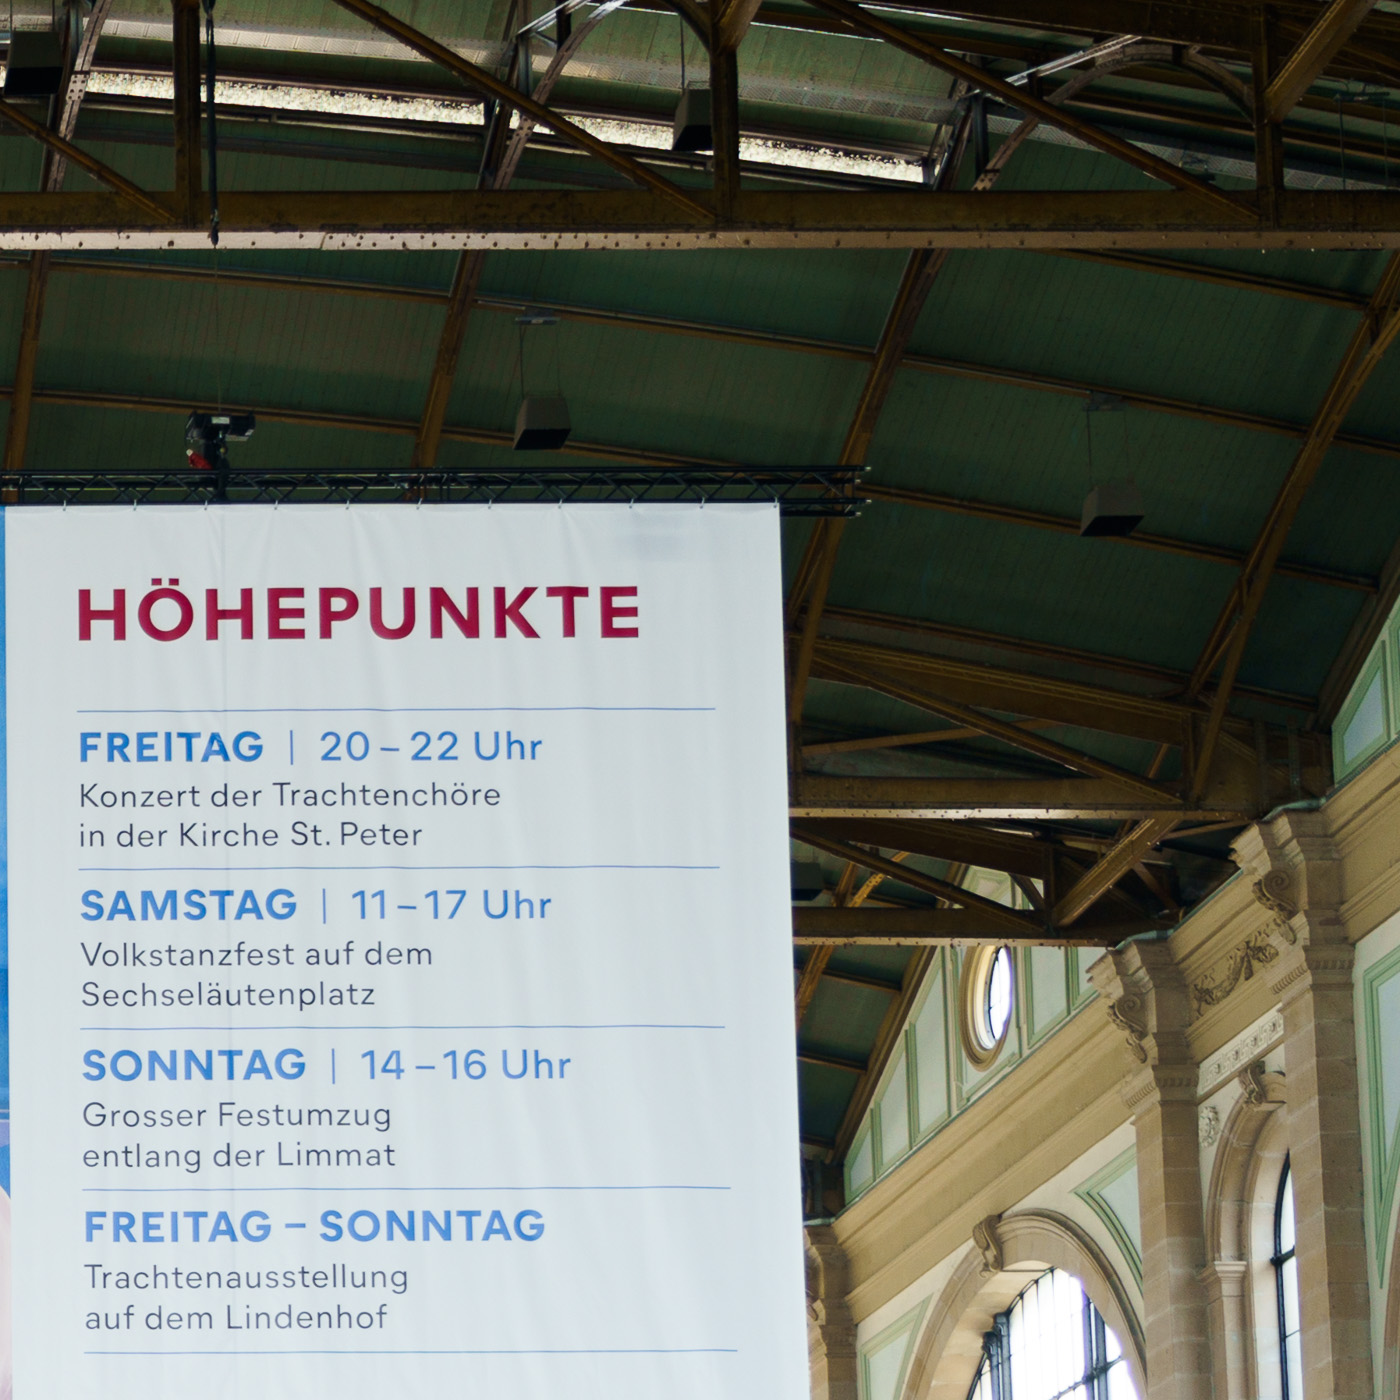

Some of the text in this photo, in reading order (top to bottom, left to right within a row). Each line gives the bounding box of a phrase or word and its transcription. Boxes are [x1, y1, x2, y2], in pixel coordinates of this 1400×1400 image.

[79, 578, 638, 641] HÖHEPUNKTE
[80, 731, 263, 762] FREITAG
[475, 731, 542, 760] Uhr
[81, 782, 500, 807] Konzert der Trachtenchöre
[81, 824, 104, 846] in
[117, 824, 167, 847] der
[181, 823, 278, 846] Kirche
[341, 822, 422, 846] Peter
[81, 889, 296, 921] SAMSTAG
[484, 890, 551, 919] Uhr
[81, 941, 431, 966] Volkstanzfest auf dem
[82, 981, 374, 1011] Sechseläutenplatz
[83, 1048, 305, 1081] SONNTAG
[503, 1049, 571, 1079] Uhr
[84, 1102, 390, 1132] Grosser Festumzug
[83, 1142, 395, 1173] entlang der Limmat
[86, 1211, 271, 1242] FREITAG
[320, 1210, 544, 1242] SONNTAG
[84, 1264, 407, 1294] Trachtenausstellung
[86, 1304, 387, 1330] auf dem Lindenhof
